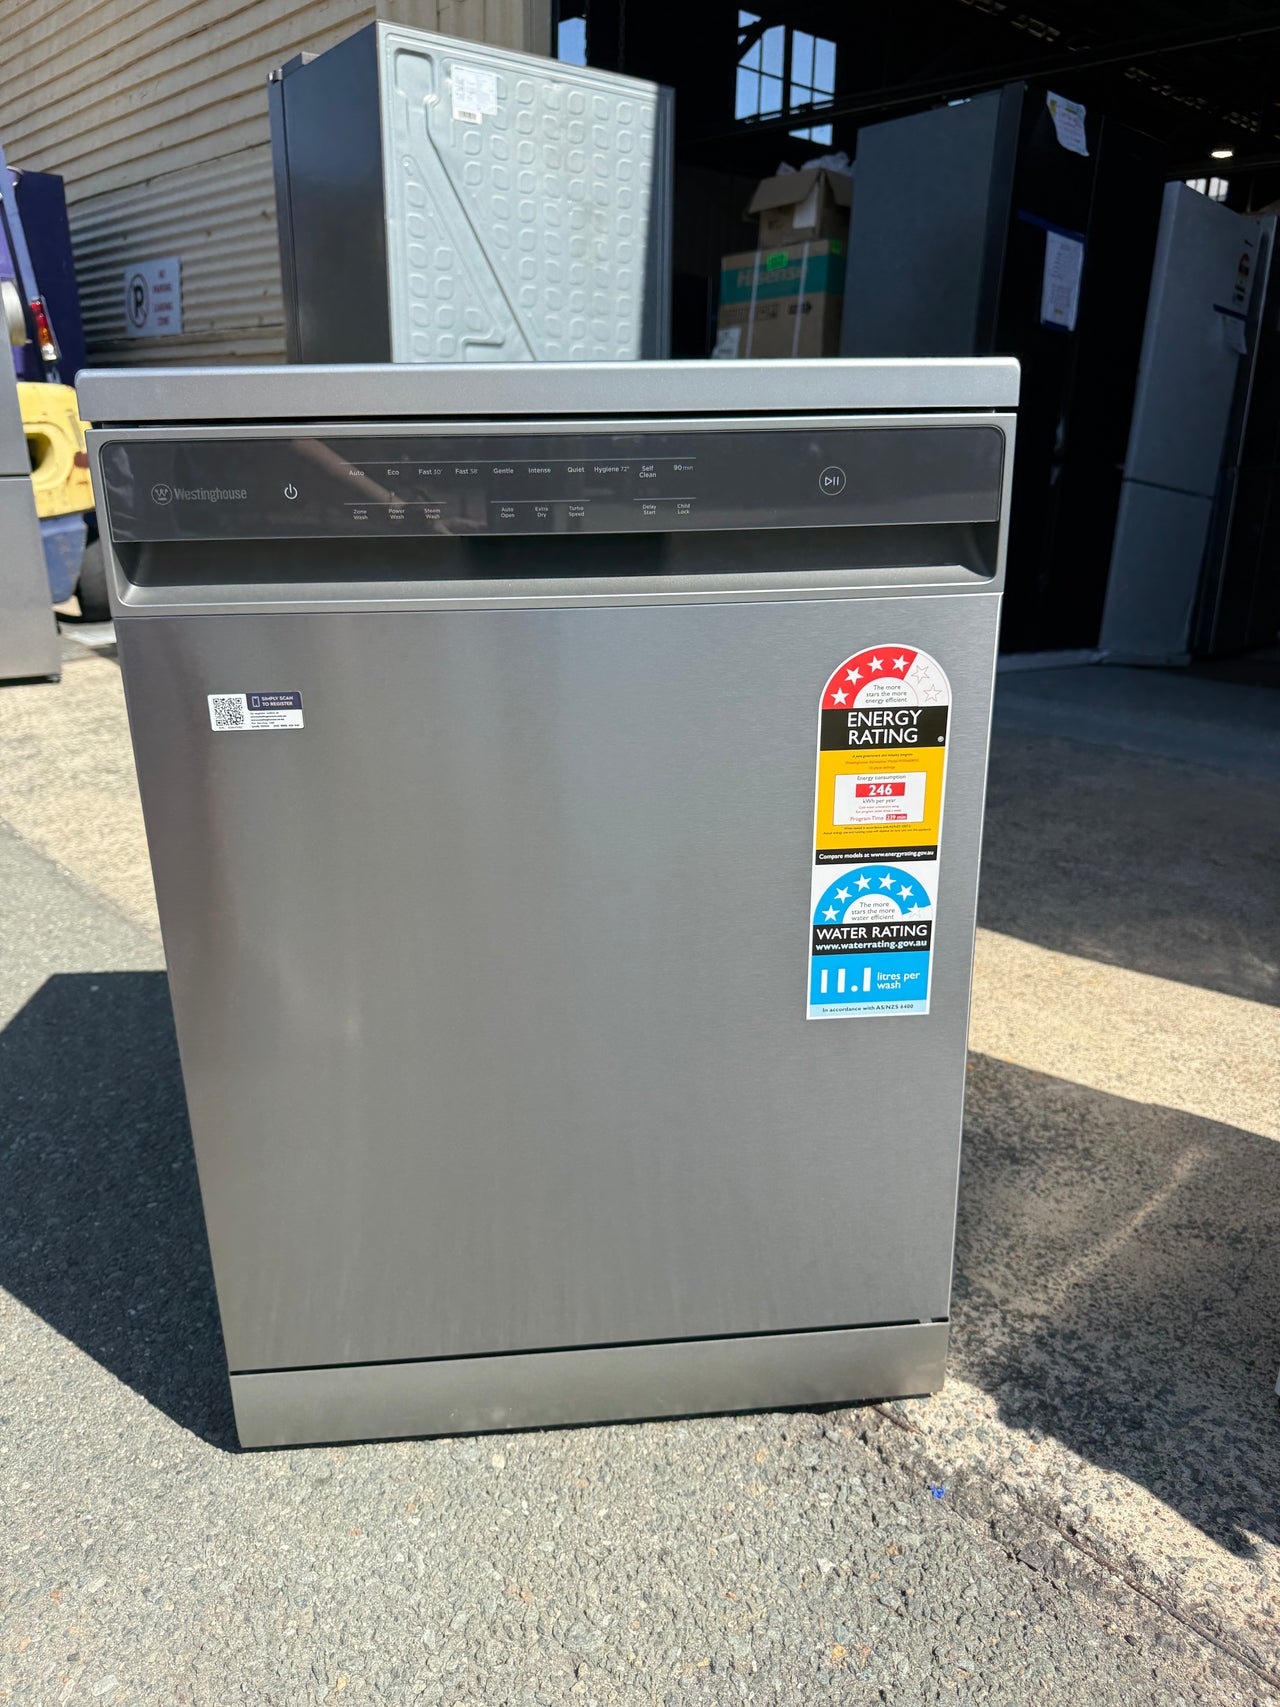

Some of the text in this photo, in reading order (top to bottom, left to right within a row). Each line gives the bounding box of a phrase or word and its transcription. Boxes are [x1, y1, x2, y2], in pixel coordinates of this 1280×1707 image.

[349, 469, 365, 477] Auto
[493, 467, 514, 475] Gentle
[567, 466, 585, 474] Quiet
[594, 466, 620, 474] Hygiene
[174, 487, 248, 503] Westinghouse
[847, 709, 922, 728] ENERGY
[848, 728, 918, 745] RATING
[869, 784, 893, 796] 246
[816, 925, 927, 940] WATER RATING
[816, 939, 927, 950] www.waterrating.gov.au
[821, 967, 872, 993] 11.1
[877, 972, 920, 981] litres per
[877, 981, 901, 989] wash
